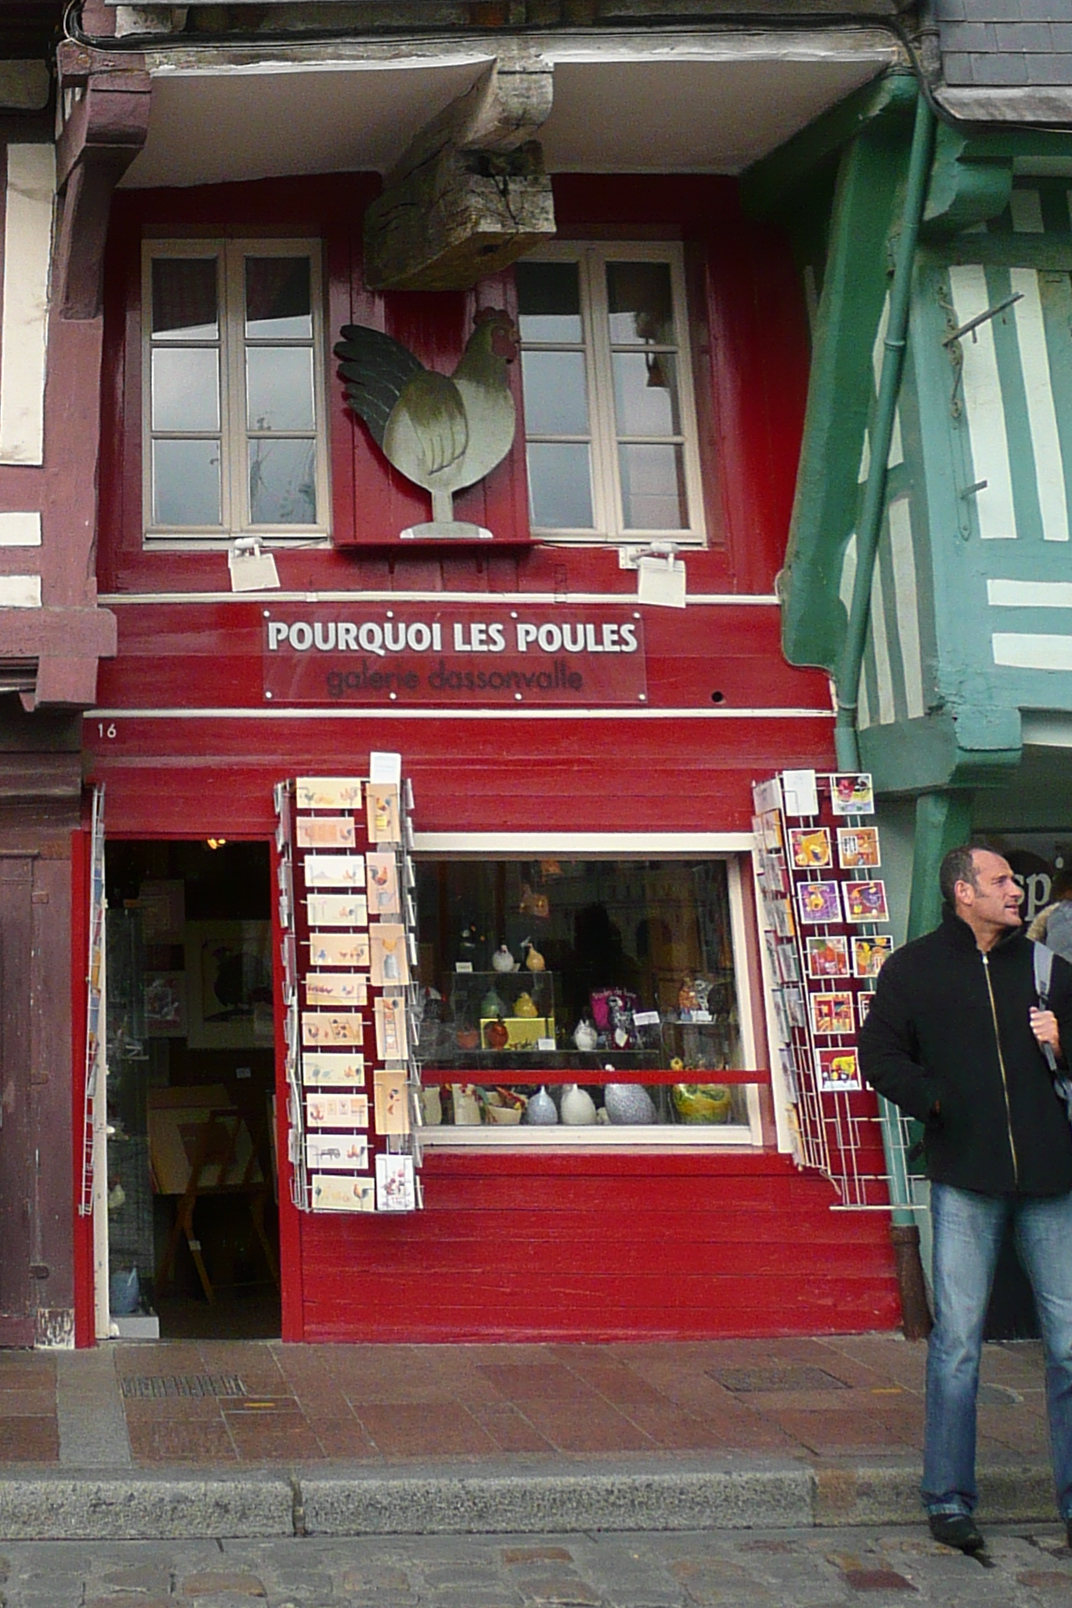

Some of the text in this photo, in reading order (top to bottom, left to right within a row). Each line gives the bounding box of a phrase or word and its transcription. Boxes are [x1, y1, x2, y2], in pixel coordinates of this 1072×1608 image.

[268, 622, 638, 656] POURQUOI LES POULES
[327, 658, 419, 697] galerie
[98, 723, 116, 738] 16
